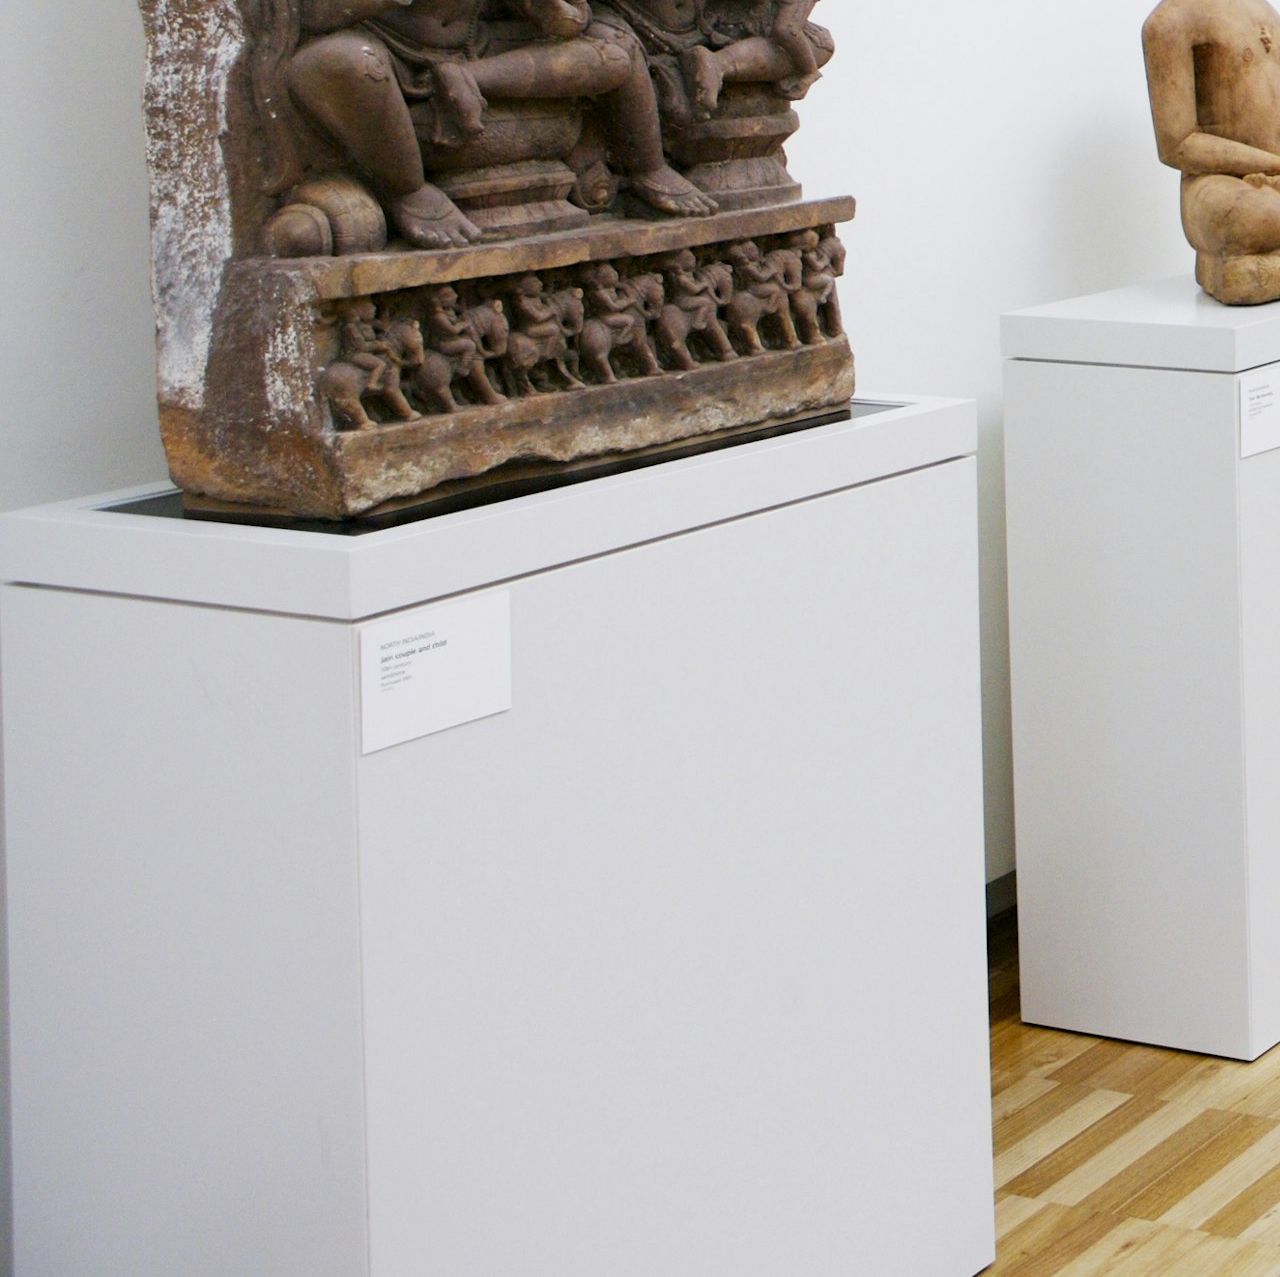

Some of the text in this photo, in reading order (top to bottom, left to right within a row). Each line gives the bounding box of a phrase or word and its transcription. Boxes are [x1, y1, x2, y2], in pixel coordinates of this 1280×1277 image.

[395, 649, 416, 659] couple
[418, 644, 430, 653] and
[432, 639, 447, 649] child
